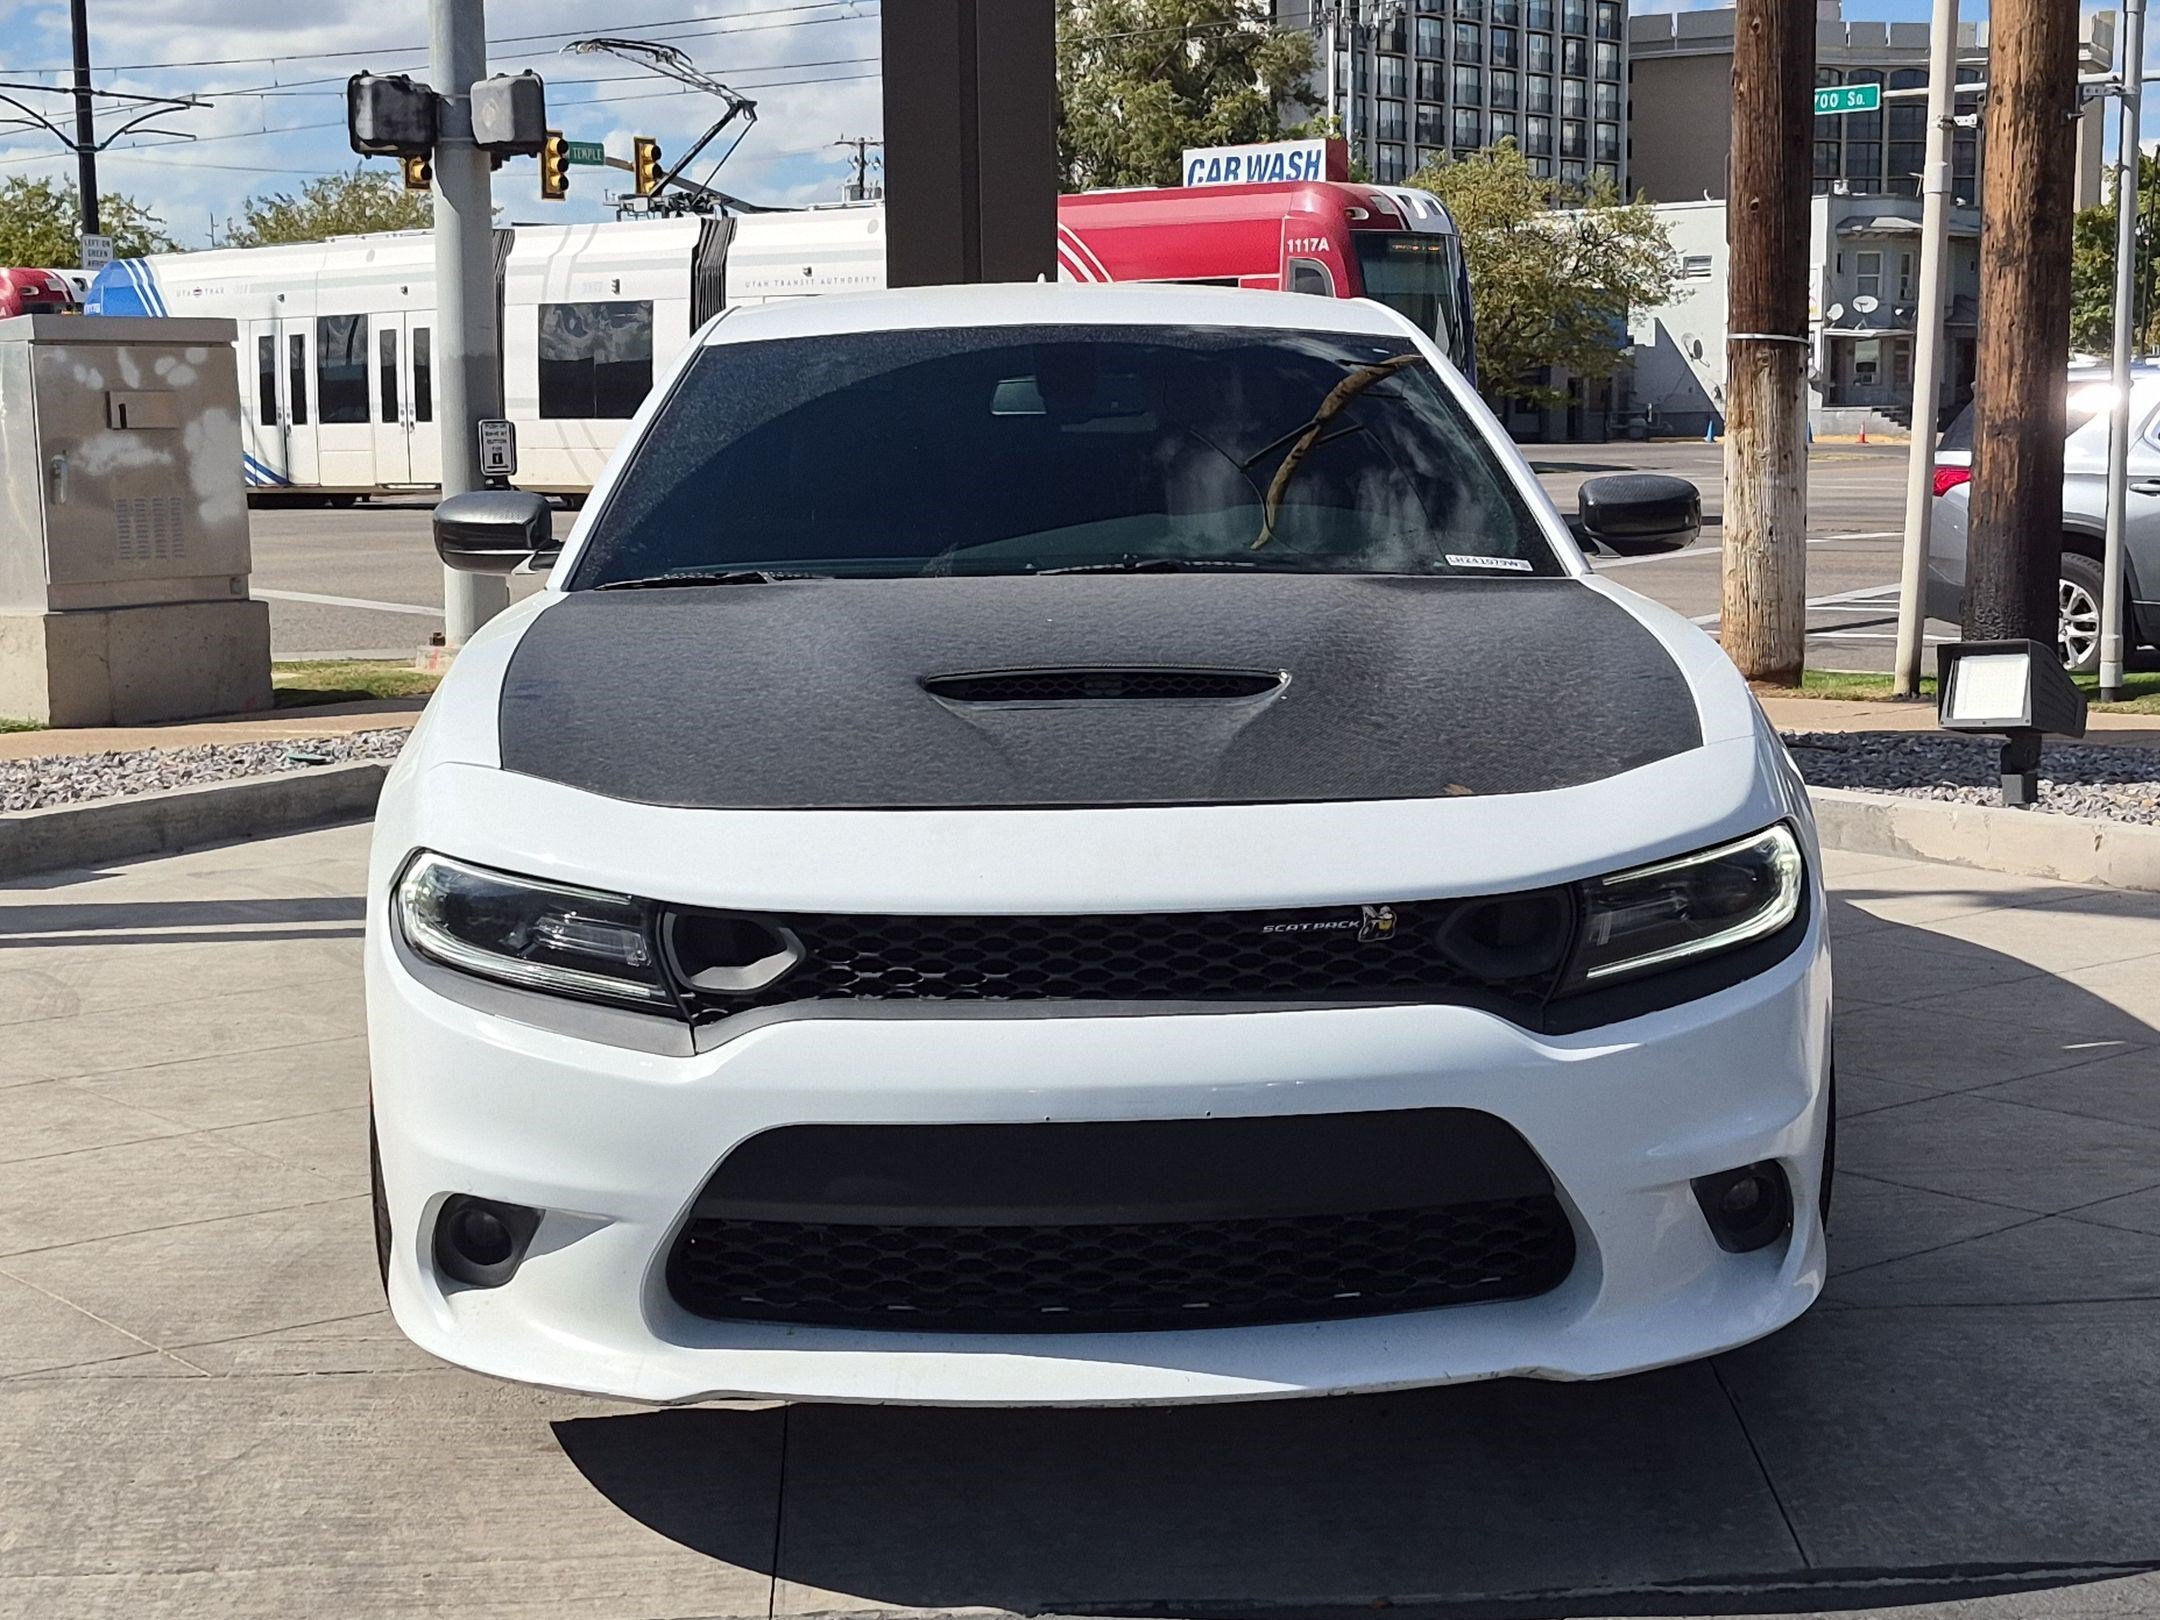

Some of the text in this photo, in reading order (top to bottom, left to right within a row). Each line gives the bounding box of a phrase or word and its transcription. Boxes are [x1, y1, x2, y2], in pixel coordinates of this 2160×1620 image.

[1847, 91, 1866, 106] So.
[573, 147, 602, 160] TEMPLE
[1188, 149, 1322, 187] CAR WASH
[1287, 236, 1330, 253] 1117A
[775, 278, 815, 287] TRANSIT
[820, 276, 877, 285] AUTHORITY
[1263, 919, 1360, 933] SCAT PACK
